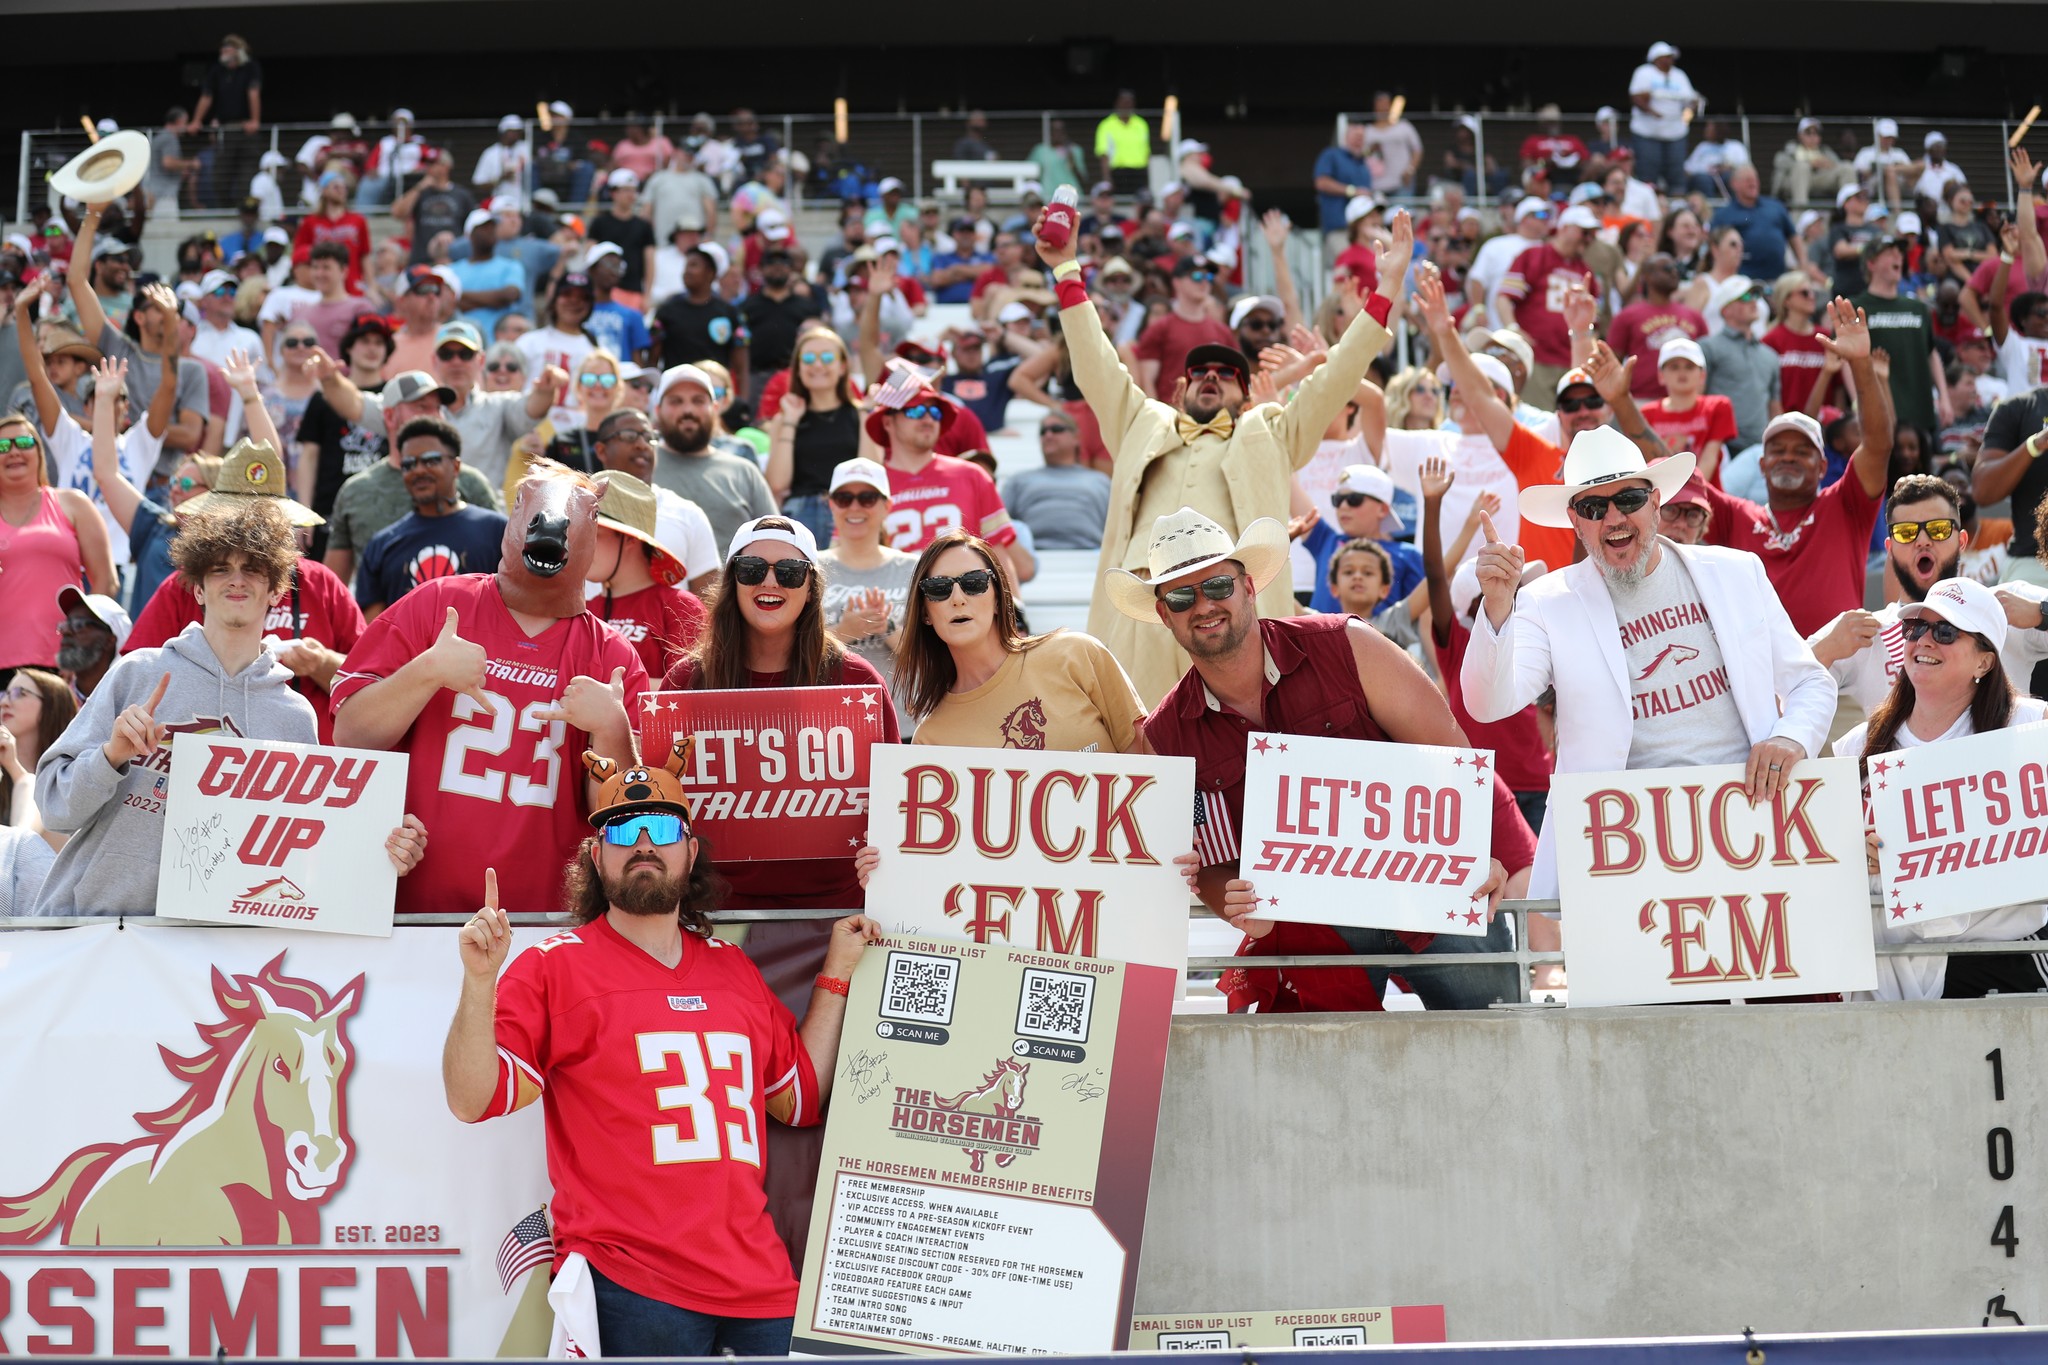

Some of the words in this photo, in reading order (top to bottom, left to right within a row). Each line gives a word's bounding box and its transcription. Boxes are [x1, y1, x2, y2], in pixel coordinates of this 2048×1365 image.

[1619, 602, 1709, 649] RMINGHA
[485, 659, 558, 689] TALLION
[495, 658, 558, 674] BIRMINGHAM
[438, 689, 567, 809] 23
[797, 726, 855, 782] GO
[197, 744, 379, 809] GIDDY
[123, 793, 161, 814] 2022
[685, 787, 870, 821] TALLIONS
[898, 763, 1163, 867] BUCK
[1276, 774, 1392, 841] LET'S
[1403, 785, 1462, 847] GO
[1902, 770, 2012, 843] LET'S
[2018, 762, 2048, 820] G
[236, 814, 326, 868] UP
[1582, 778, 1840, 877] BUCK
[1252, 840, 1478, 887] STALLIONS
[229, 899, 320, 921] STALLIONS
[867, 939, 904, 950] EMAIL
[907, 941, 938, 953] SIGN
[940, 944, 957, 955] UP
[960, 946, 987, 959] LIST
[1637, 891, 1801, 985] 'EM
[1008, 952, 1070, 970] FACEBOOK
[1074, 961, 1115, 975] GROUP
[896, 1027, 923, 1040] SCAN
[924, 1031, 940, 1041] ME
[1032, 1045, 1059, 1058] SCAN
[1061, 1049, 1076, 1059] ME
[635, 1031, 761, 1170] 33
[895, 1086, 932, 1107] THE
[891, 1105, 1041, 1147] HORSEMEN
[895, 1131, 939, 1143] BIRMINGHAM
[939, 1137, 975, 1148] STALLIONS
[976, 1142, 1014, 1153] SUPPORTER
[839, 1156, 862, 1170] THE
[866, 1160, 937, 1180] HORSEMEN
[941, 1170, 1028, 1193] MEMBERSHIP
[1031, 1180, 1093, 1202] BENEFITS
[847, 1179, 868, 1189] FREE
[870, 1182, 925, 1197] MEMBERSHIP
[846, 1191, 890, 1204] EXCLUSIVE
[929, 1202, 953, 1213] WHEN
[955, 1206, 999, 1220] AVAILABLE
[847, 1203, 861, 1212] VIP
[862, 1205, 895, 1216] ACCESS
[897, 1209, 907, 1218] TO
[909, 1211, 916, 1220] A
[918, 1212, 969, 1227] PRE-SEASON
[972, 1220, 1006, 1232] KICKOFF
[1008, 1225, 1034, 1236] EVENT
[335, 1226, 377, 1243] EST.
[385, 1225, 440, 1243] 2023
[844, 1226, 875, 1238] PLAYER
[877, 1230, 883, 1239] &
[885, 1231, 913, 1243] COACH
[915, 1236, 969, 1251] INTERACTION
[845, 1214, 895, 1229] COMMUNITY
[897, 1221, 952, 1237] ENGAGEMENT
[954, 1229, 985, 1241] EVENTS
[837, 1248, 896, 1264] MERCHANDISE
[898, 1257, 939, 1270] DISCOUNT
[941, 1263, 963, 1273] CODE
[971, 1267, 989, 1278] 30%
[991, 1270, 1007, 1280] OFF
[838, 1236, 882, 1250] EXCLUSIVE
[885, 1243, 919, 1256] SEATING
[921, 1248, 956, 1260] SECTION
[958, 1253, 1000, 1267] RESERVED
[1002, 1260, 1018, 1270] FOR
[1020, 1262, 1036, 1272] THE
[1038, 1265, 1084, 1279] HORSEMEN
[833, 1271, 885, 1286] VIDEOBOARD
[887, 1279, 922, 1292] FEATURE
[924, 1286, 946, 1295] EACH
[948, 1288, 972, 1299] GAME
[835, 1260, 878, 1273] EXCLUSIVE
[881, 1267, 923, 1280] FACEBOOK
[925, 1273, 953, 1284] GROUP
[831, 1283, 869, 1296] CREATIVE
[872, 1289, 928, 1305] SUGGESTIONS
[930, 1297, 936, 1306] &
[939, 1299, 963, 1310] INPUT
[833, 1295, 855, 1306] TEAM
[858, 1299, 882, 1310] INTRO
[884, 1303, 907, 1314] SONG
[0, 1266, 449, 1357] SEMEN
[831, 1307, 848, 1317] 3RD
[850, 1310, 887, 1323] QUARTER
[889, 1315, 913, 1327] SONG
[1133, 1320, 1171, 1331] EMAIL
[1174, 1318, 1204, 1330] SIGN
[1207, 1318, 1224, 1329] UP
[1227, 1317, 1253, 1328] LIST
[1275, 1313, 1338, 1326] FACEBOOK
[1341, 1311, 1382, 1324] GROUP
[829, 1319, 897, 1336] ENTERTAINMENT
[898, 1329, 934, 1342] OPTIONS
